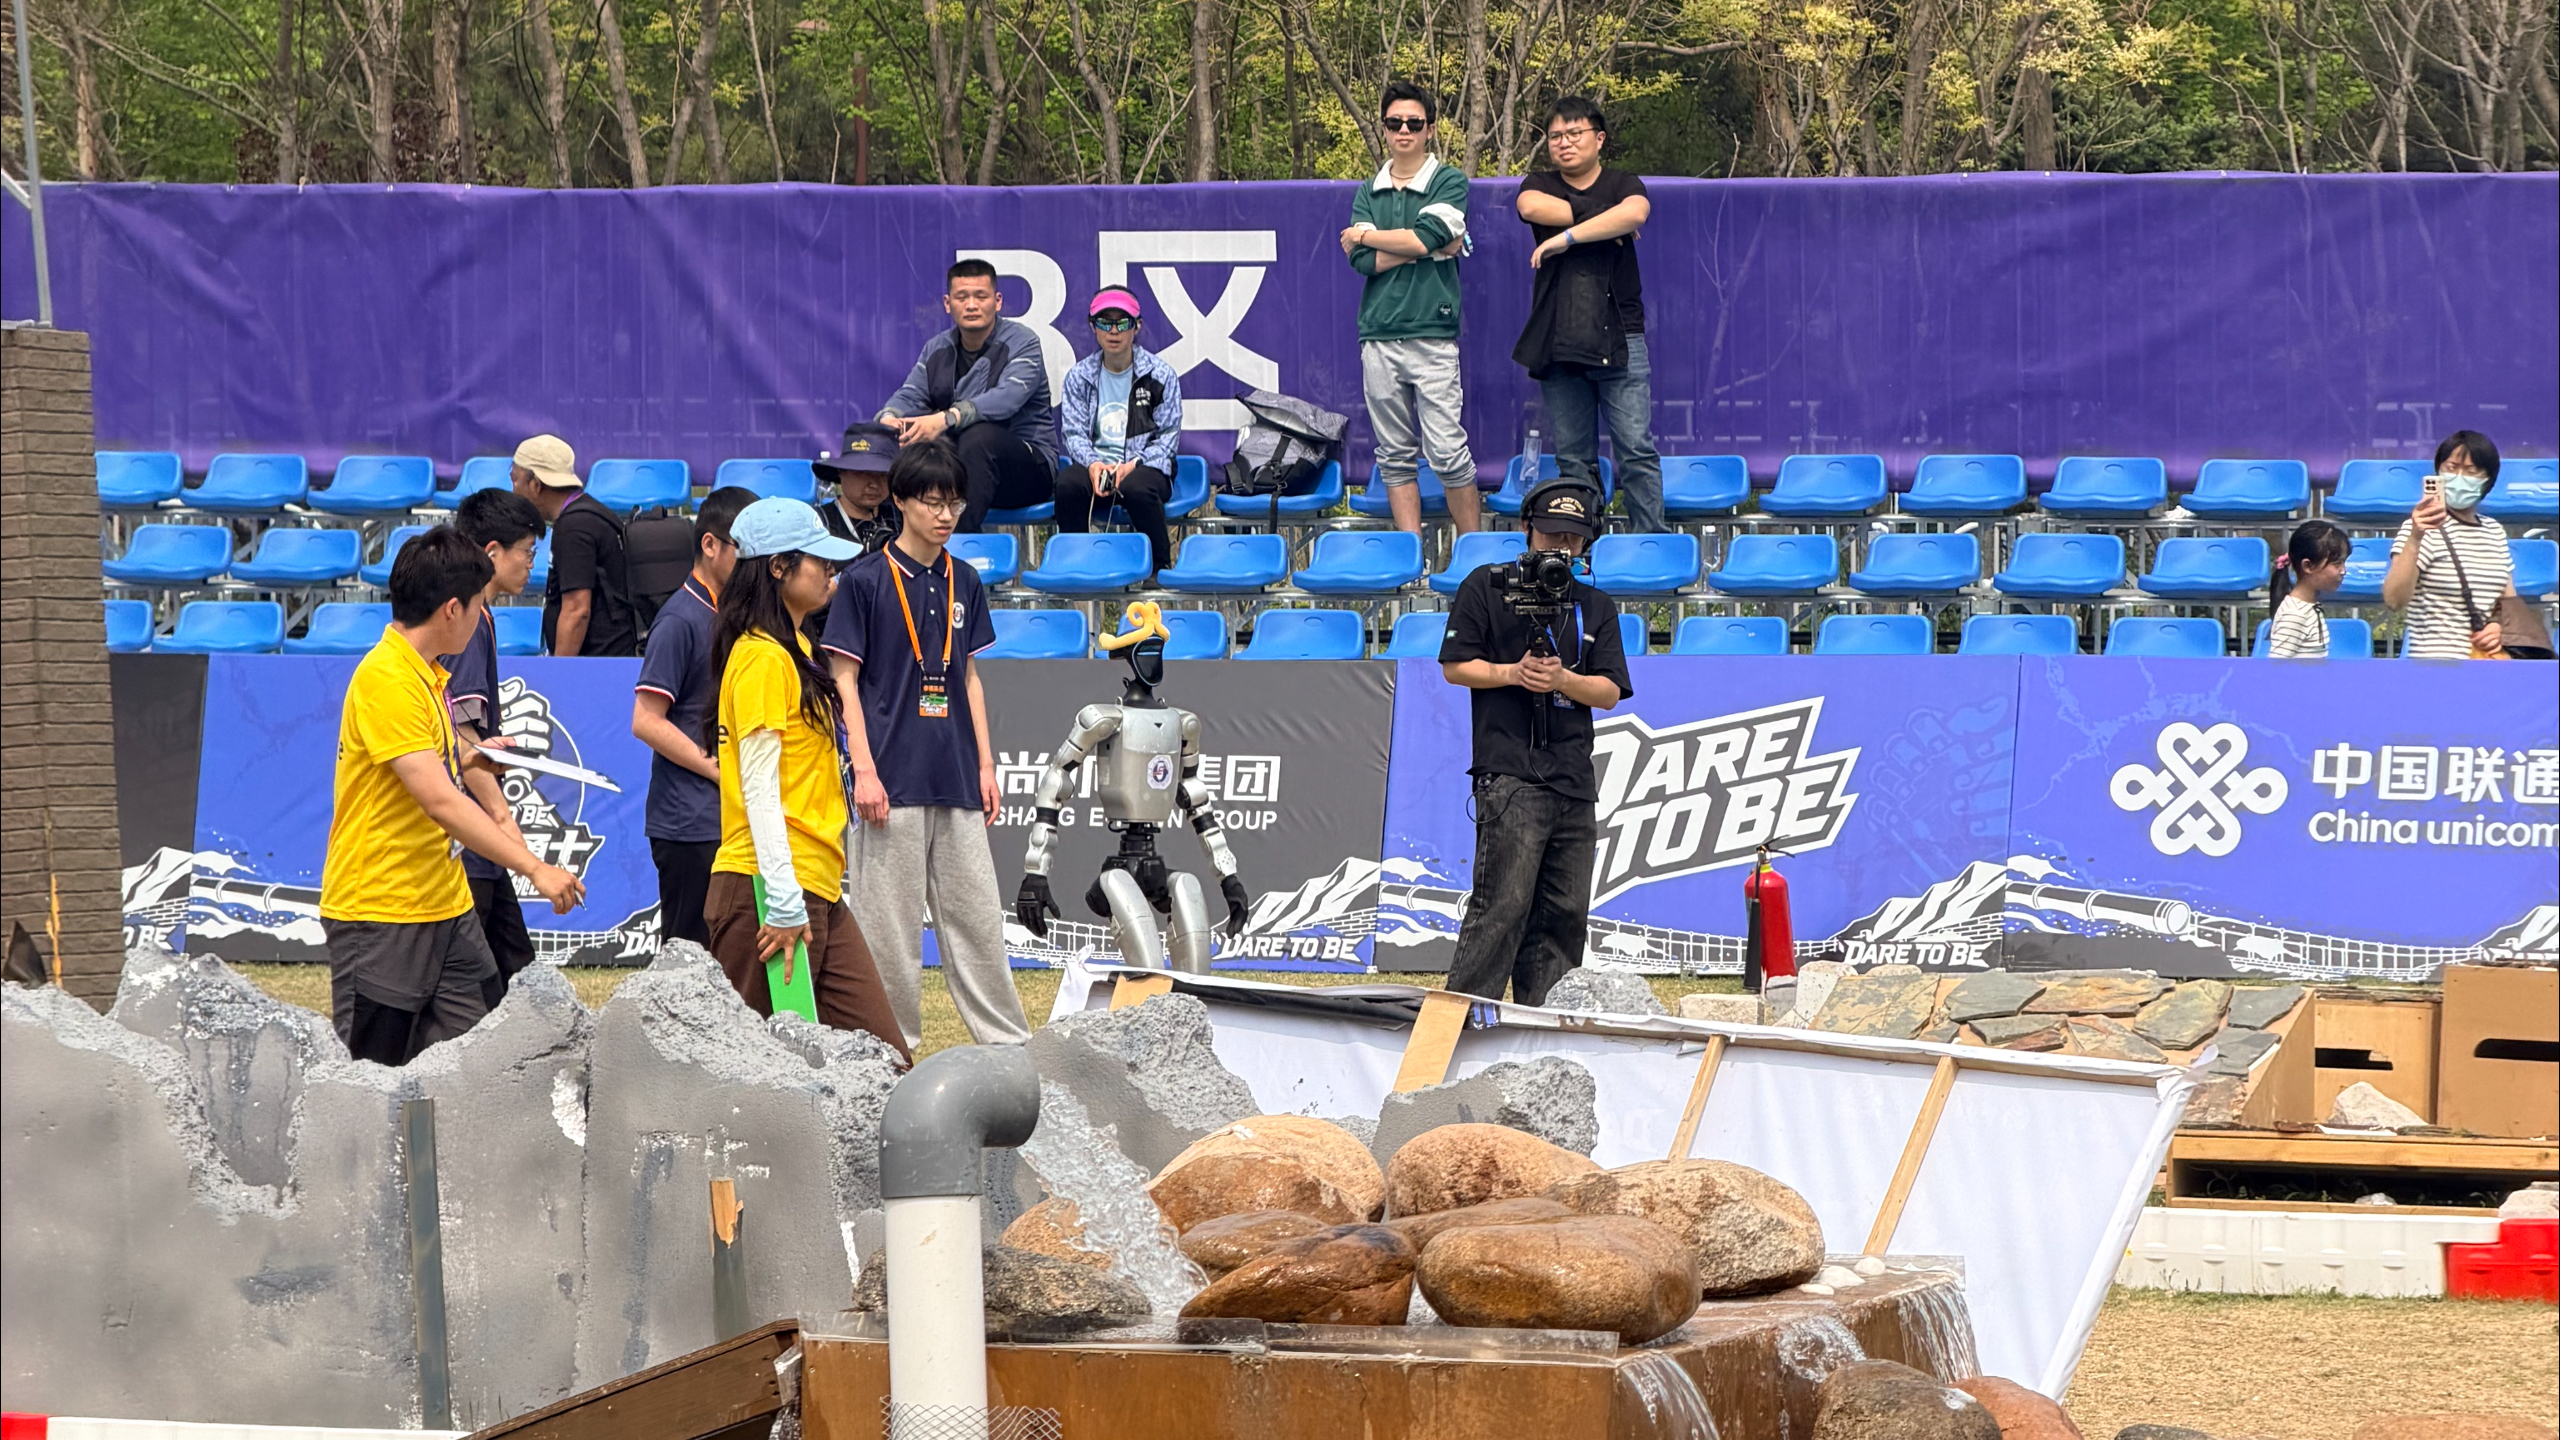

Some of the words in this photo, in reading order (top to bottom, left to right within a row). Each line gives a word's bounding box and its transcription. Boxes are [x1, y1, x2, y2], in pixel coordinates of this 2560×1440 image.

[1591, 715, 1801, 823] DARE
[2312, 742, 2559, 804] 中国联通
[994, 806, 1076, 827] SHAG
[1213, 809, 1278, 831] ROUP
[1606, 792, 1712, 884] TO
[1713, 765, 1839, 854] BE
[2308, 808, 2419, 843] China
[1212, 932, 1287, 960] DARE
[1289, 936, 1319, 958] TO
[1320, 936, 1364, 962] BE
[1842, 940, 1912, 966] DARE
[1915, 943, 1947, 966] TO
[1947, 941, 1993, 968] BE
